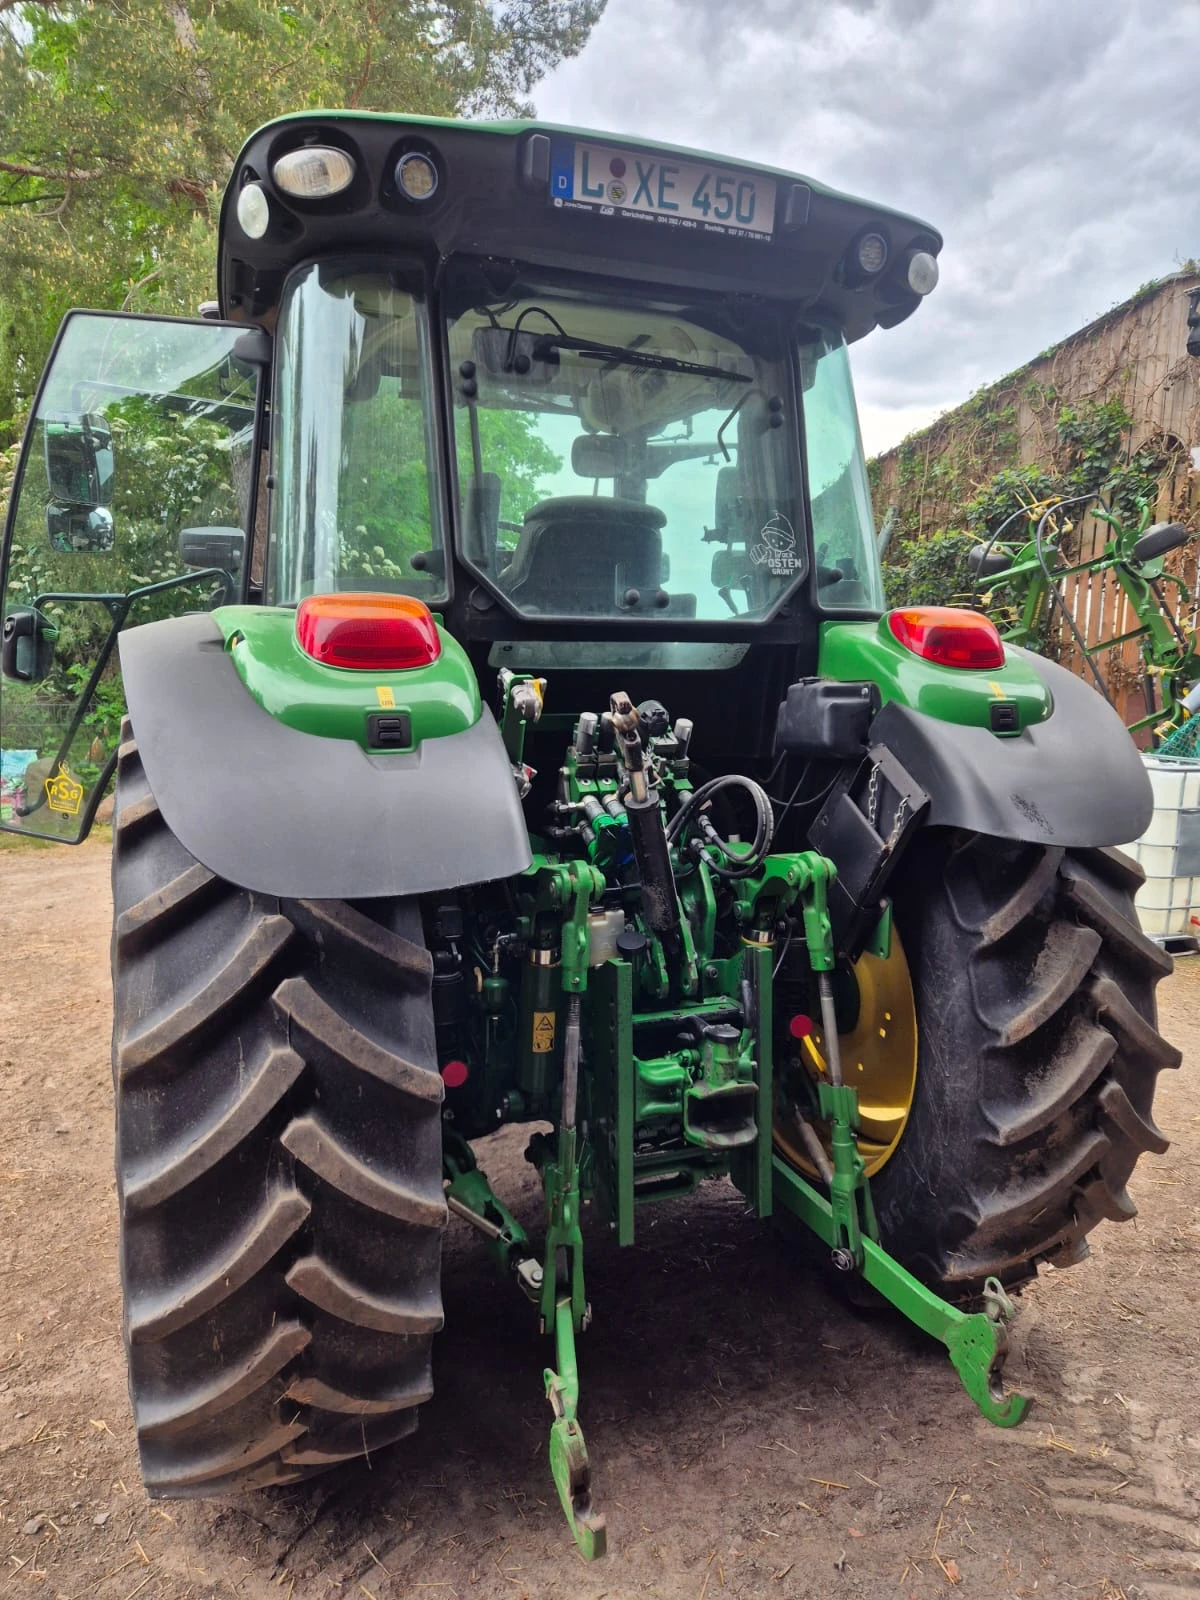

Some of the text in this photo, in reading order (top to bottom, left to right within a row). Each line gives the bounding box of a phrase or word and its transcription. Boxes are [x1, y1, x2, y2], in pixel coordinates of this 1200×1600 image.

[558, 151, 757, 224] D L XE 450
[768, 558, 802, 569] OSTEN
